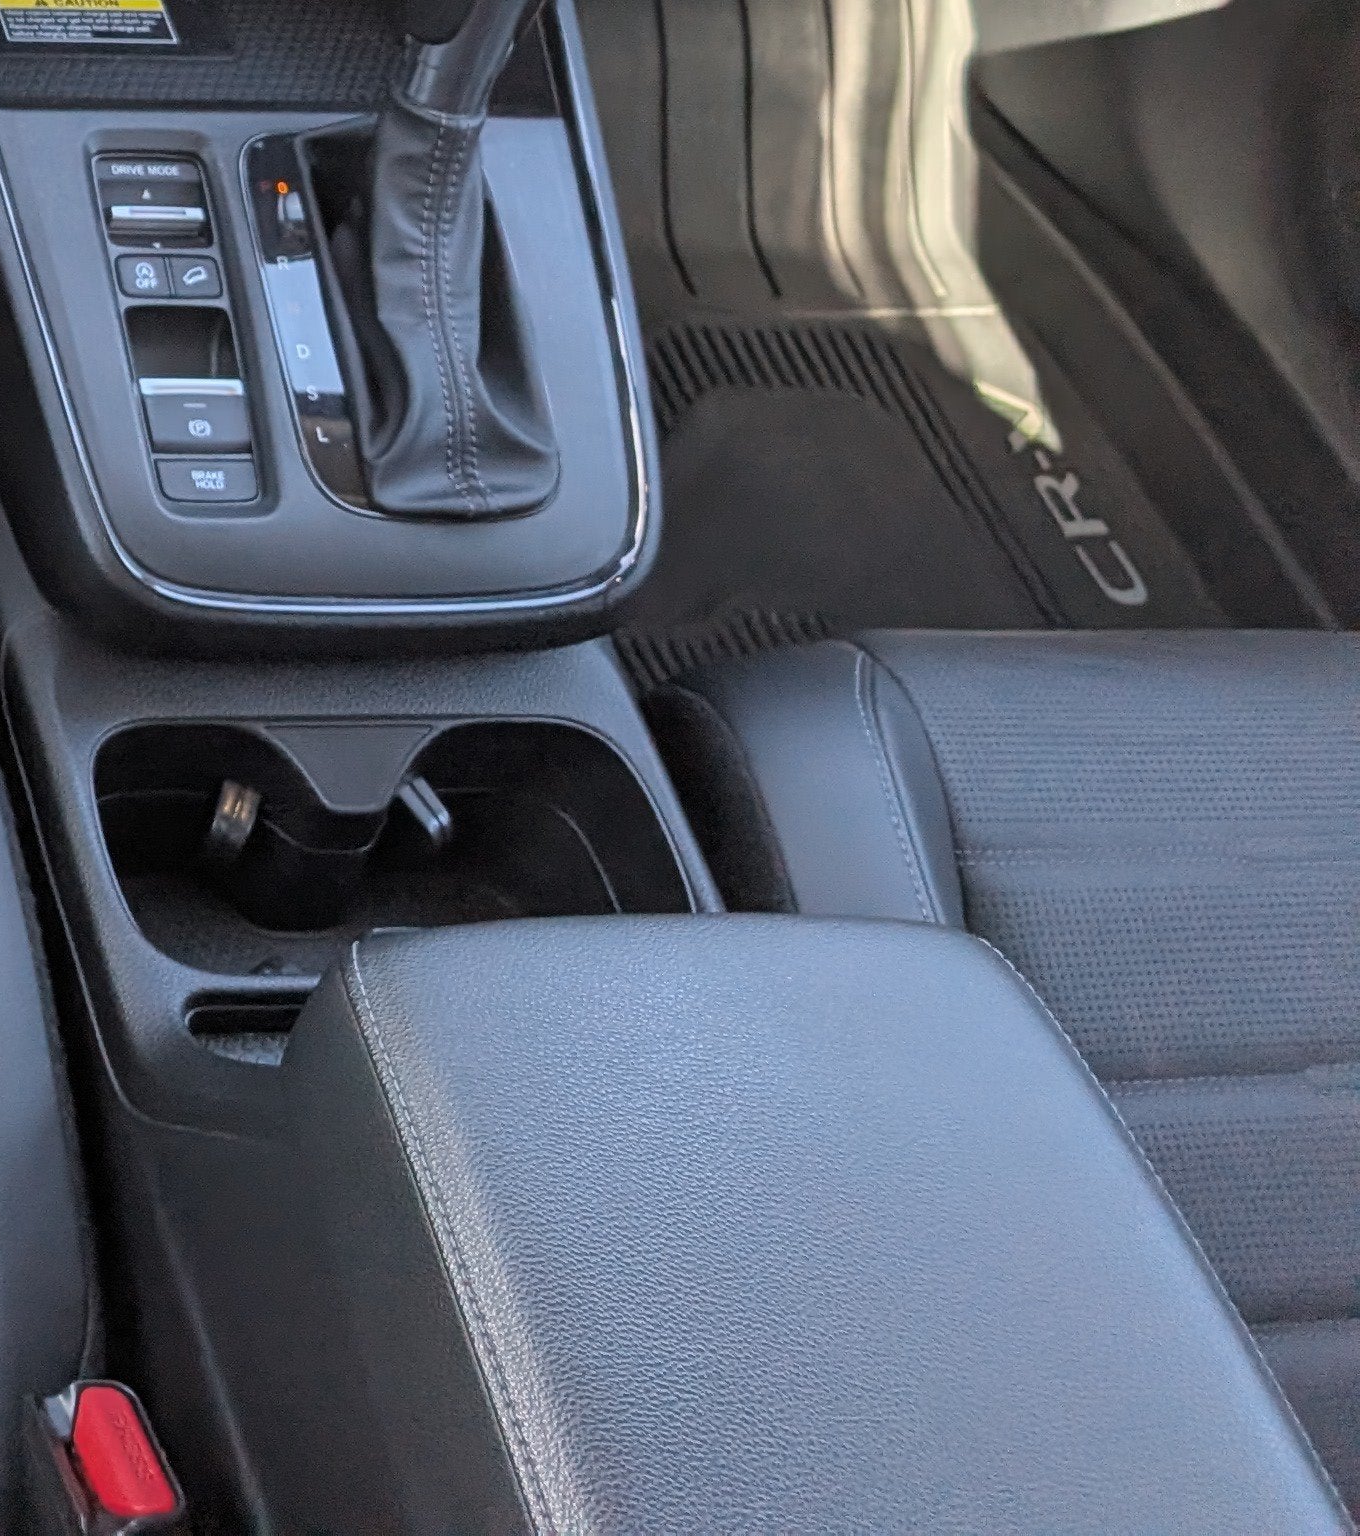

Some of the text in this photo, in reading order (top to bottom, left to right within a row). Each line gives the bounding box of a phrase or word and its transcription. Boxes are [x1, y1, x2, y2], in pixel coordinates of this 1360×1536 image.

[110, 163, 180, 176] DRIVE MODE
[277, 255, 290, 271] R
[135, 277, 158, 290] OFF
[296, 343, 311, 360] D
[305, 385, 320, 401] S
[315, 426, 329, 444] L
[191, 469, 225, 480] BRAKE
[195, 479, 225, 491] HOLD
